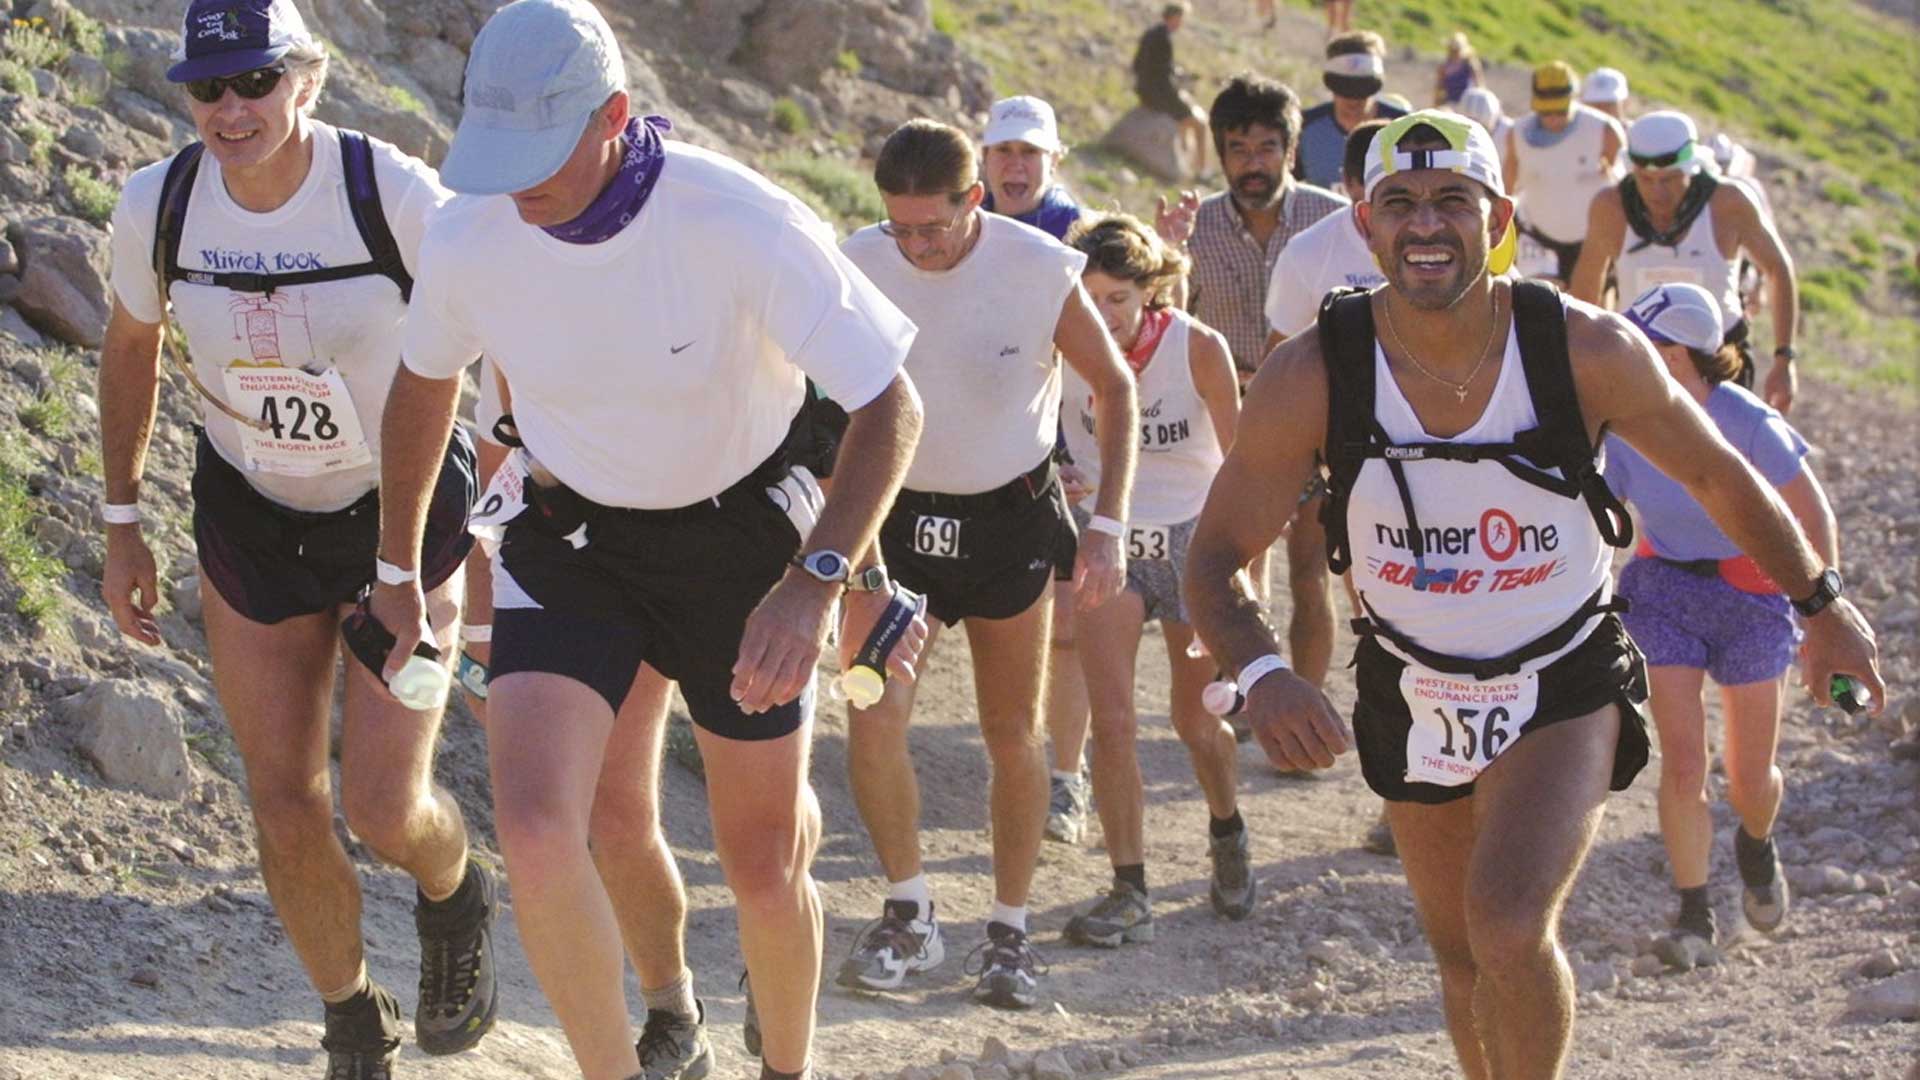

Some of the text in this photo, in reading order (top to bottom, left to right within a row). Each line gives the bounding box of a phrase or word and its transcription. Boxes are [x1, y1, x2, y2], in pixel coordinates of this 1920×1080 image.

[239, 375, 293, 383] WESTERN
[240, 383, 307, 394] ENDURANCE
[261, 396, 339, 441] 428
[1158, 419, 1189, 445] DEN
[255, 439, 347, 452] THE NORTH FACE
[917, 516, 957, 555] 69
[1129, 528, 1165, 559] 53
[1378, 560, 1557, 594] RUNG TEAM
[1414, 688, 1519, 703] ENDURANCE RUN
[1416, 677, 1519, 693] WESTERN STATES
[1433, 706, 1510, 761] 156
[1422, 755, 1443, 769] THE
